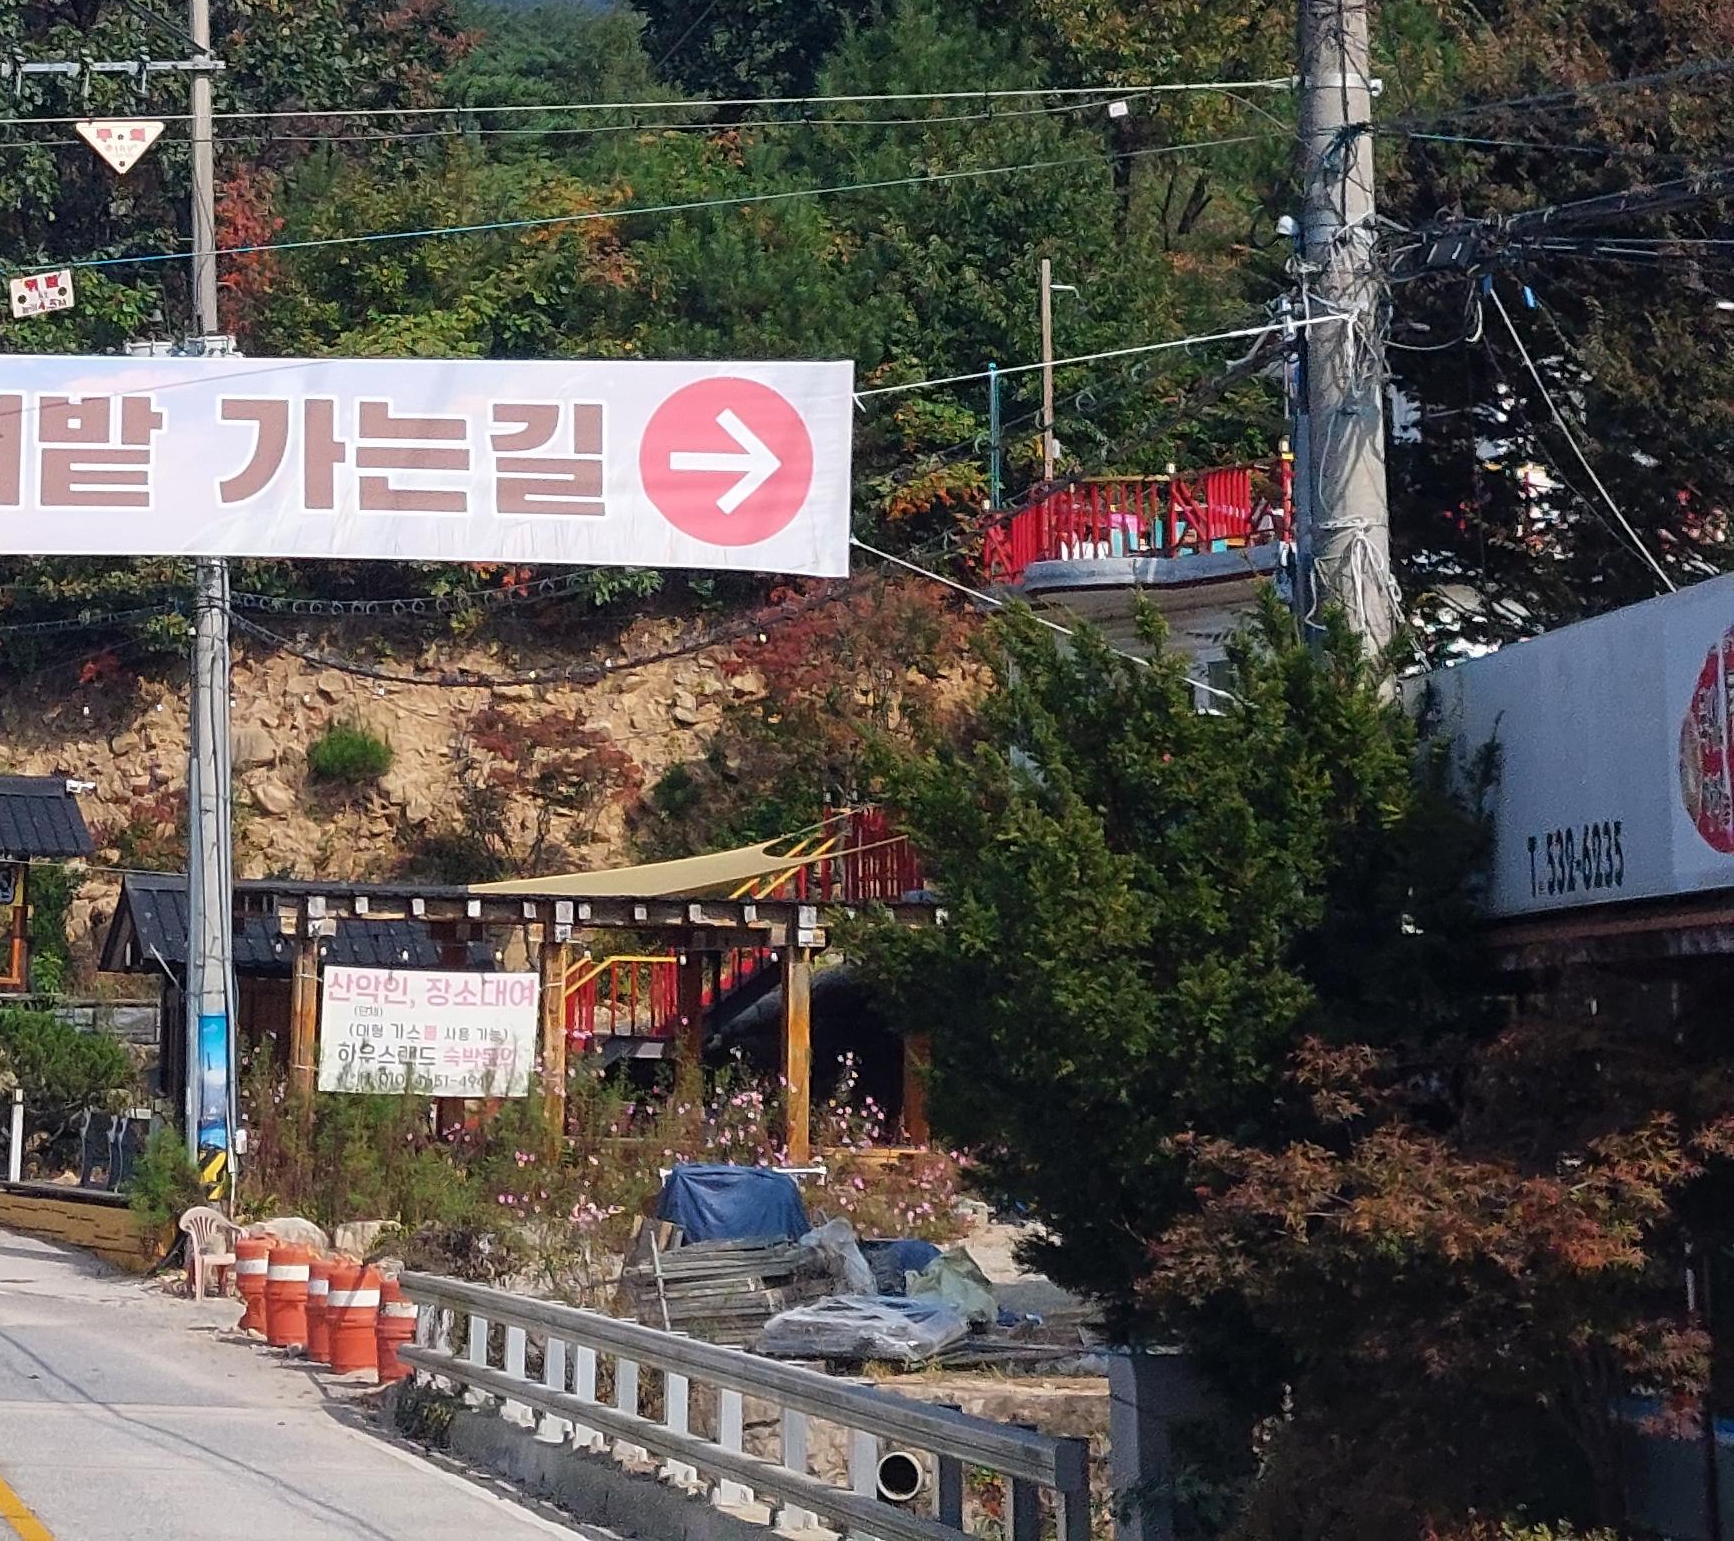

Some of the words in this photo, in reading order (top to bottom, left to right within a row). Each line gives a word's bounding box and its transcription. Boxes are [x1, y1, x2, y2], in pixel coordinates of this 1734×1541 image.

[220, 399, 605, 515] 가는길
[327, 973, 415, 1009] 산악인,
[425, 977, 535, 1007] 장소대여
